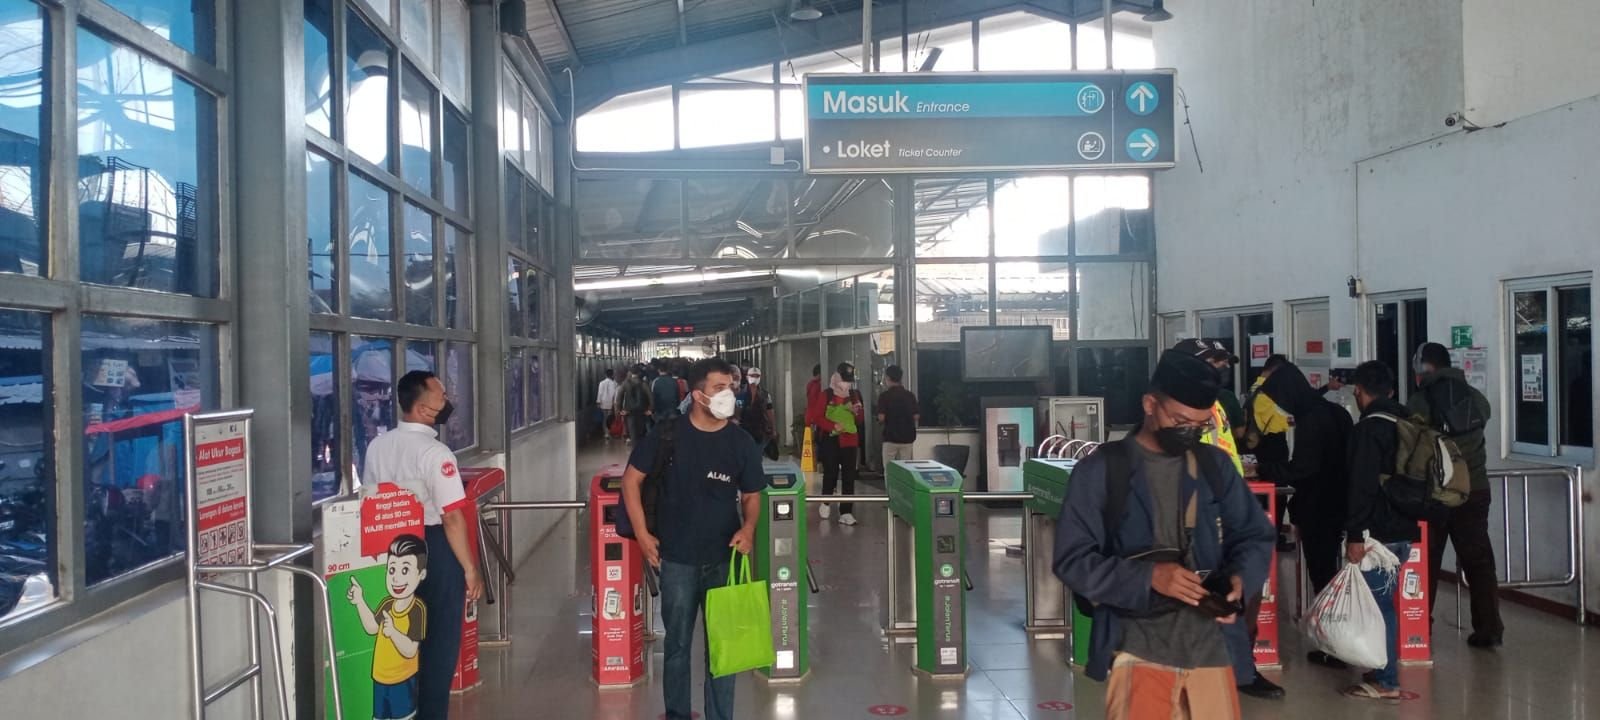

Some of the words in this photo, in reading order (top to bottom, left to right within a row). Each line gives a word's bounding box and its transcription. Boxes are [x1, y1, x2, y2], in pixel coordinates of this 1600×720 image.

[823, 90, 911, 114] Masuk
[916, 101, 970, 114] Entrance
[838, 140, 890, 158] Loket
[898, 147, 924, 158] Ticket
[926, 147, 962, 158] Counter
[199, 450, 210, 461] Alat
[211, 448, 224, 458] Ukur
[225, 442, 241, 457] Bagasi
[364, 524, 384, 534] WAJIB
[328, 564, 337, 572] 90
[338, 562, 350, 570] cm
